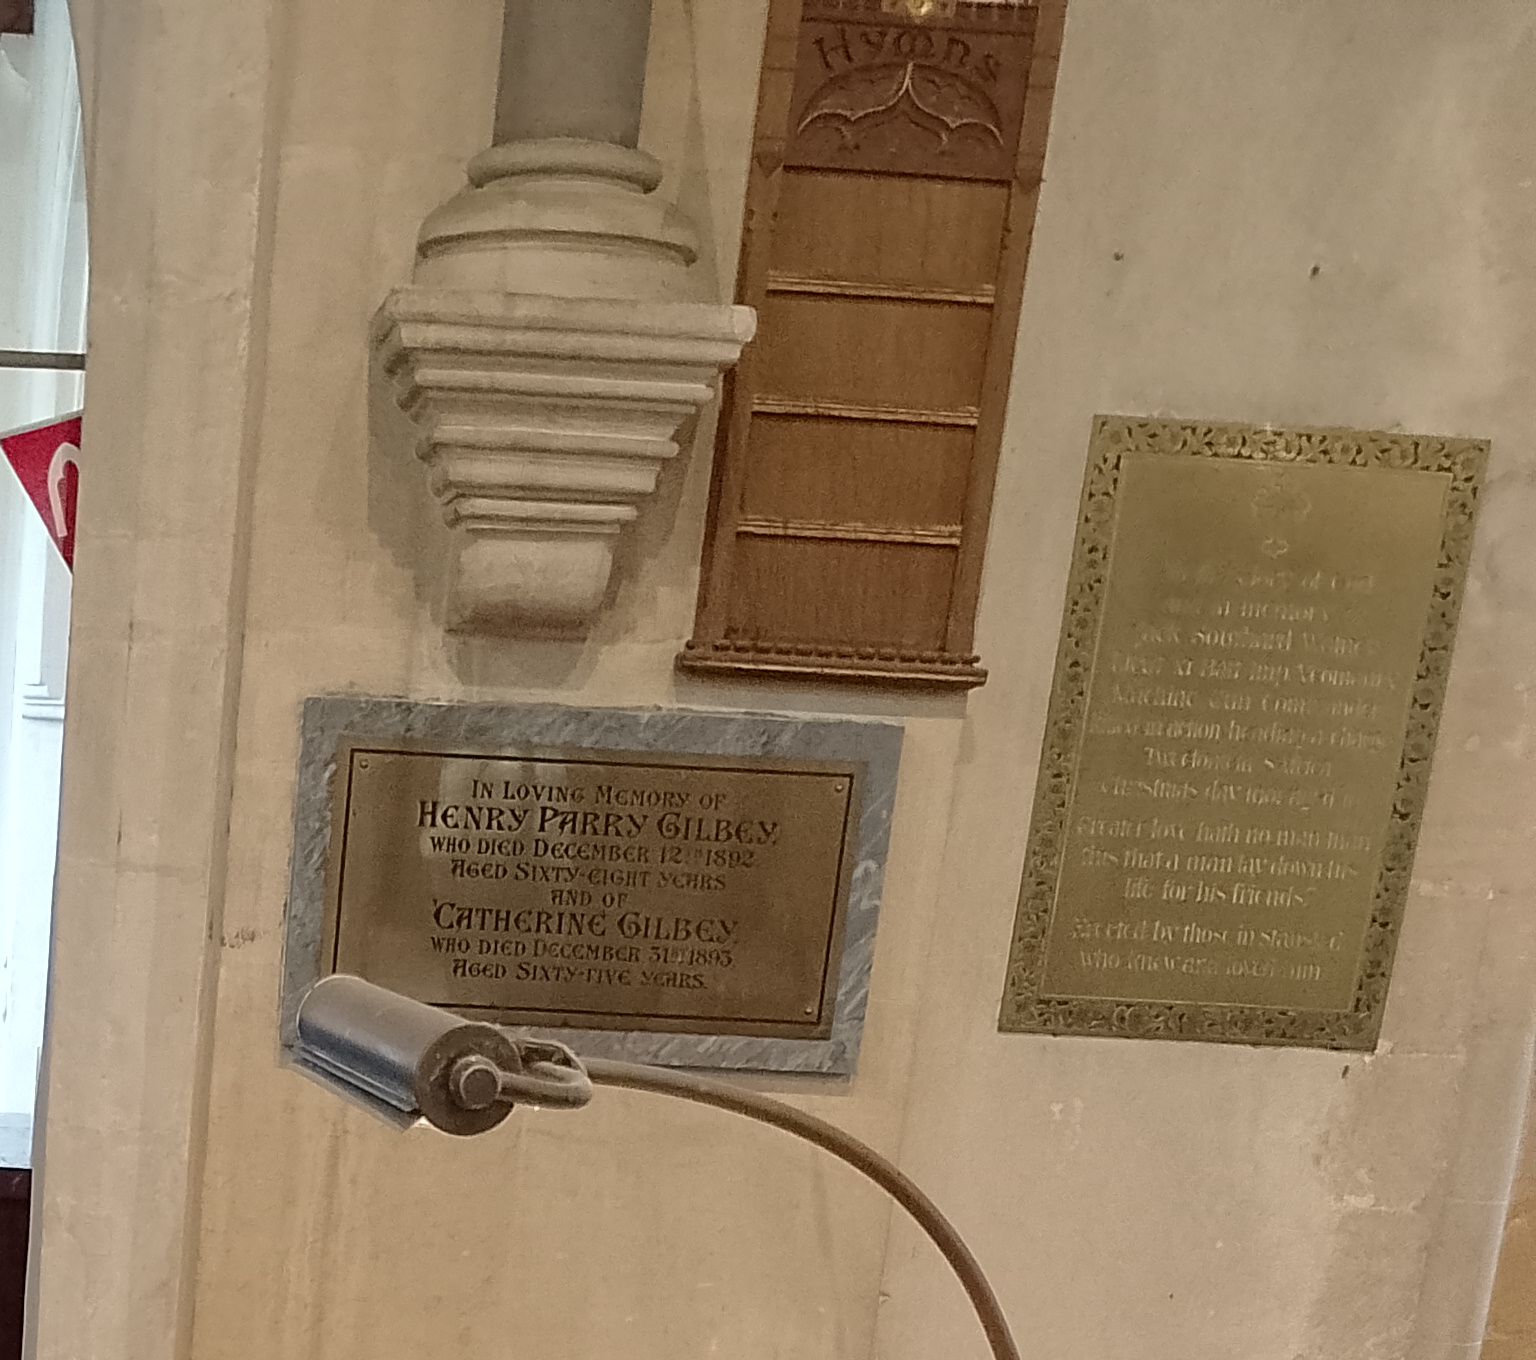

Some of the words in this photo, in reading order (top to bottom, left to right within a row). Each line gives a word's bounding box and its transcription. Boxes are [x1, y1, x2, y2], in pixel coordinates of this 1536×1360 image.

[472, 779, 494, 800] IN
[503, 780, 585, 803] LOVING
[596, 785, 690, 808] MEMORY
[699, 793, 726, 810] OF
[417, 800, 529, 832] HENRY
[538, 806, 648, 839] PARRY
[430, 835, 471, 854] WHO
[477, 837, 525, 858] DIED
[533, 838, 649, 864] DECEMBER
[1245, 827, 1271, 845] no
[451, 858, 508, 879] AGED
[514, 862, 651, 888] SIXTY-EIGHT
[1185, 855, 1233, 874] man
[551, 889, 592, 907] AND
[602, 892, 629, 908] OF
[1194, 879, 1228, 904] his
[433, 900, 606, 937] CATHERINE
[430, 936, 471, 954] WHO
[478, 939, 527, 957] DIED
[532, 938, 640, 963] DECEMBER
[452, 958, 507, 979] AGED
[516, 961, 631, 986] SIXTY-FIVE
